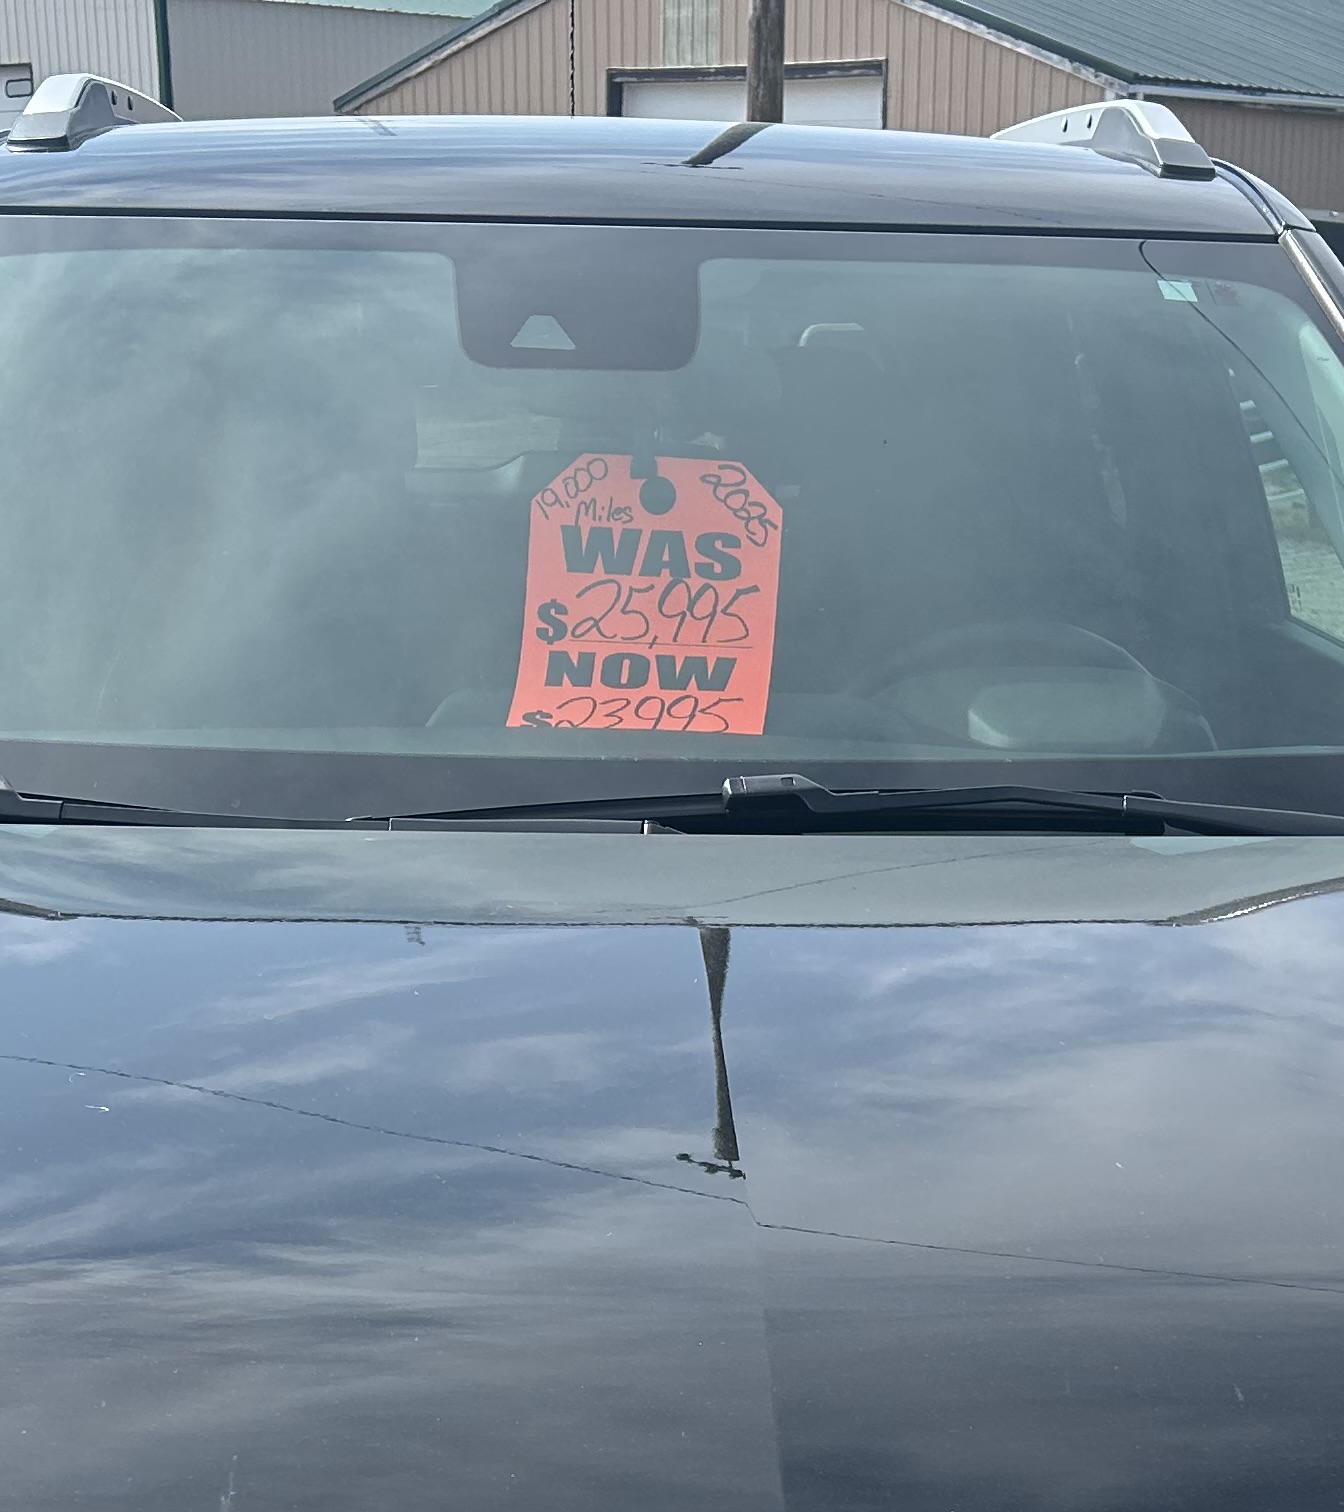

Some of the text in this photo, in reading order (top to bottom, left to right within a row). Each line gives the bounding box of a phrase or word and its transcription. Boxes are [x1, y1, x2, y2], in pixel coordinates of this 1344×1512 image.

[534, 457, 609, 521] 19,000
[574, 496, 635, 525] Miles
[700, 463, 779, 547] 2025
[561, 524, 743, 579] WAS
[544, 650, 738, 692] NOW
